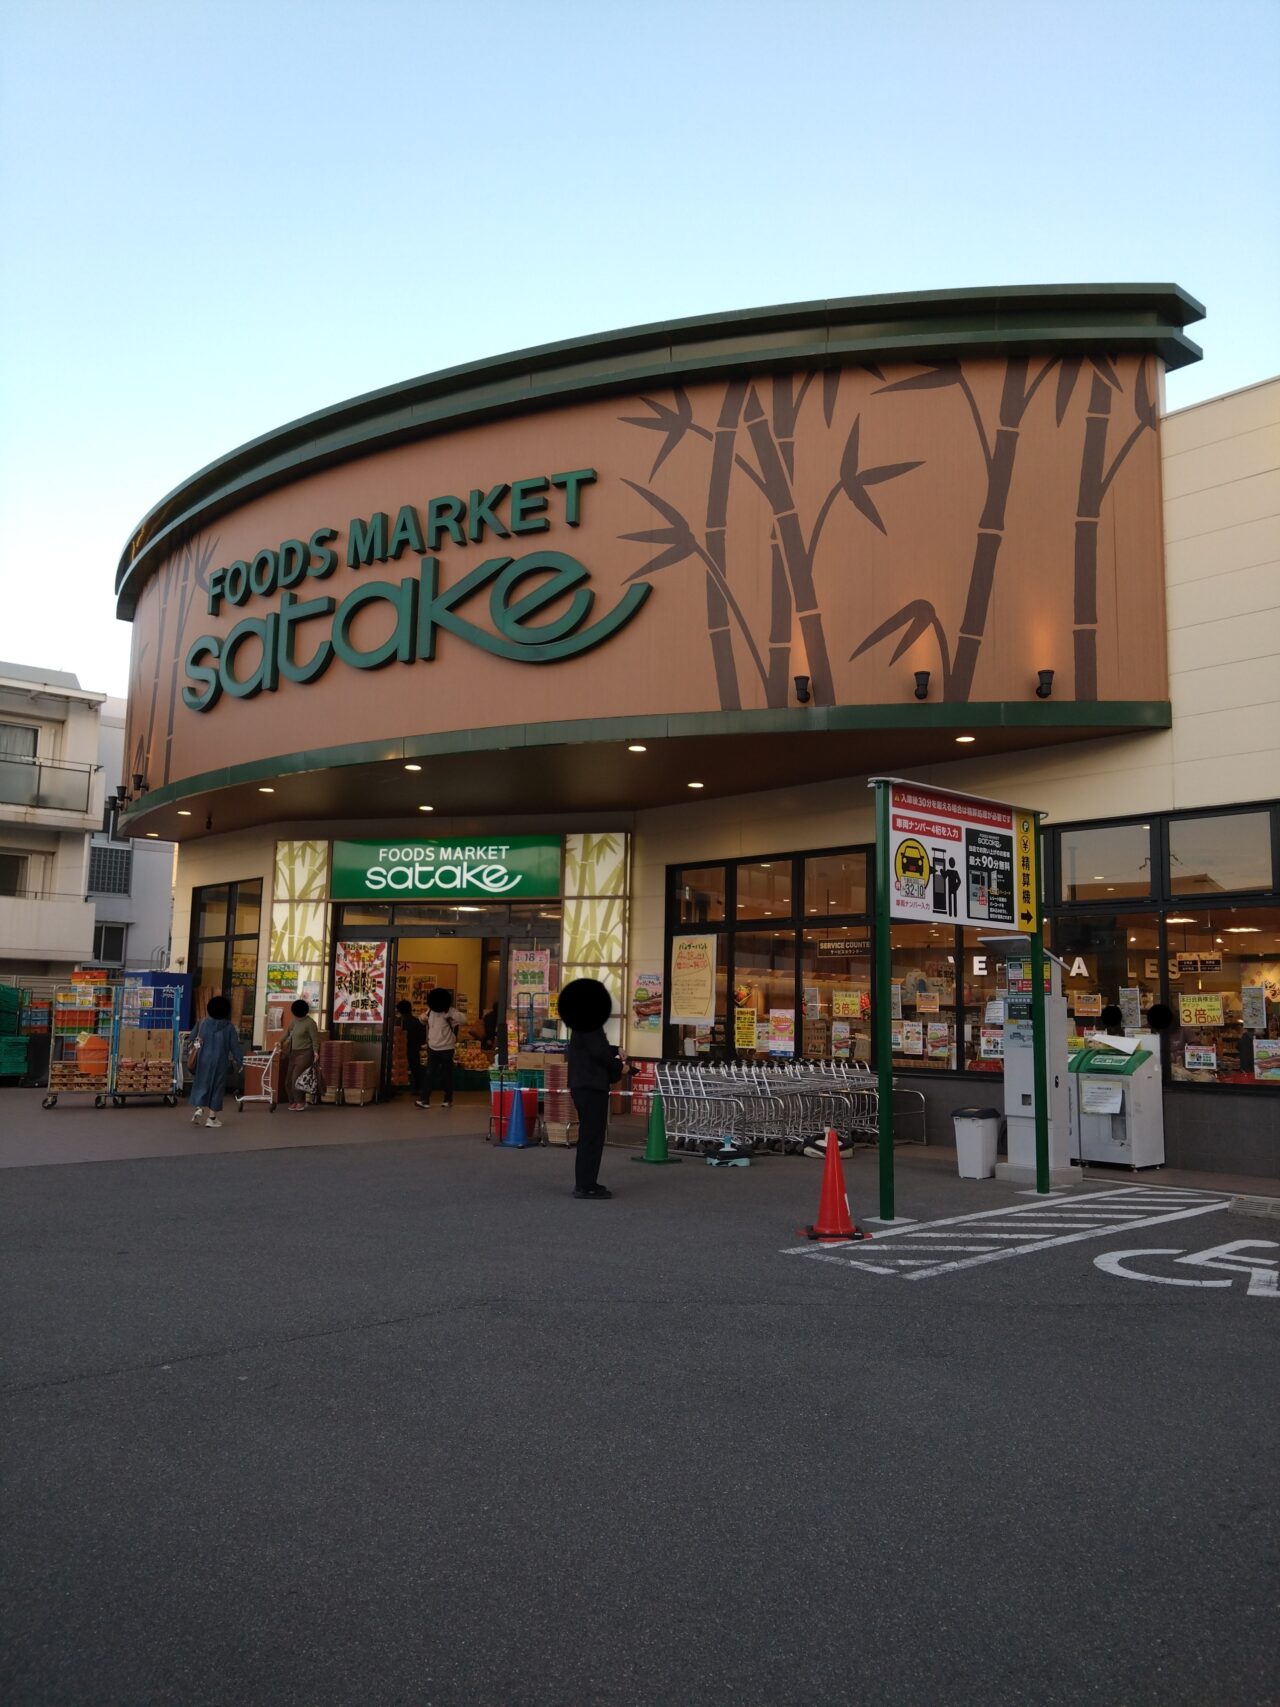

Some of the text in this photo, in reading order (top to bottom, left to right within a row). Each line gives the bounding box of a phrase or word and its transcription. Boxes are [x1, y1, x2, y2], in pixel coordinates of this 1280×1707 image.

[208, 468, 597, 616] FOODS MARKET
[182, 551, 652, 713] satake
[896, 818, 959, 838] 車両ナンバー4桁を入力
[379, 846, 510, 862] FOODS MARKET
[969, 855, 1010, 871] 最大90分無料
[365, 862, 522, 893] satake
[1021, 856, 1031, 904] 精算機
[820, 941, 871, 950] SERVICE COUNTE
[351, 998, 379, 1010] 即売会
